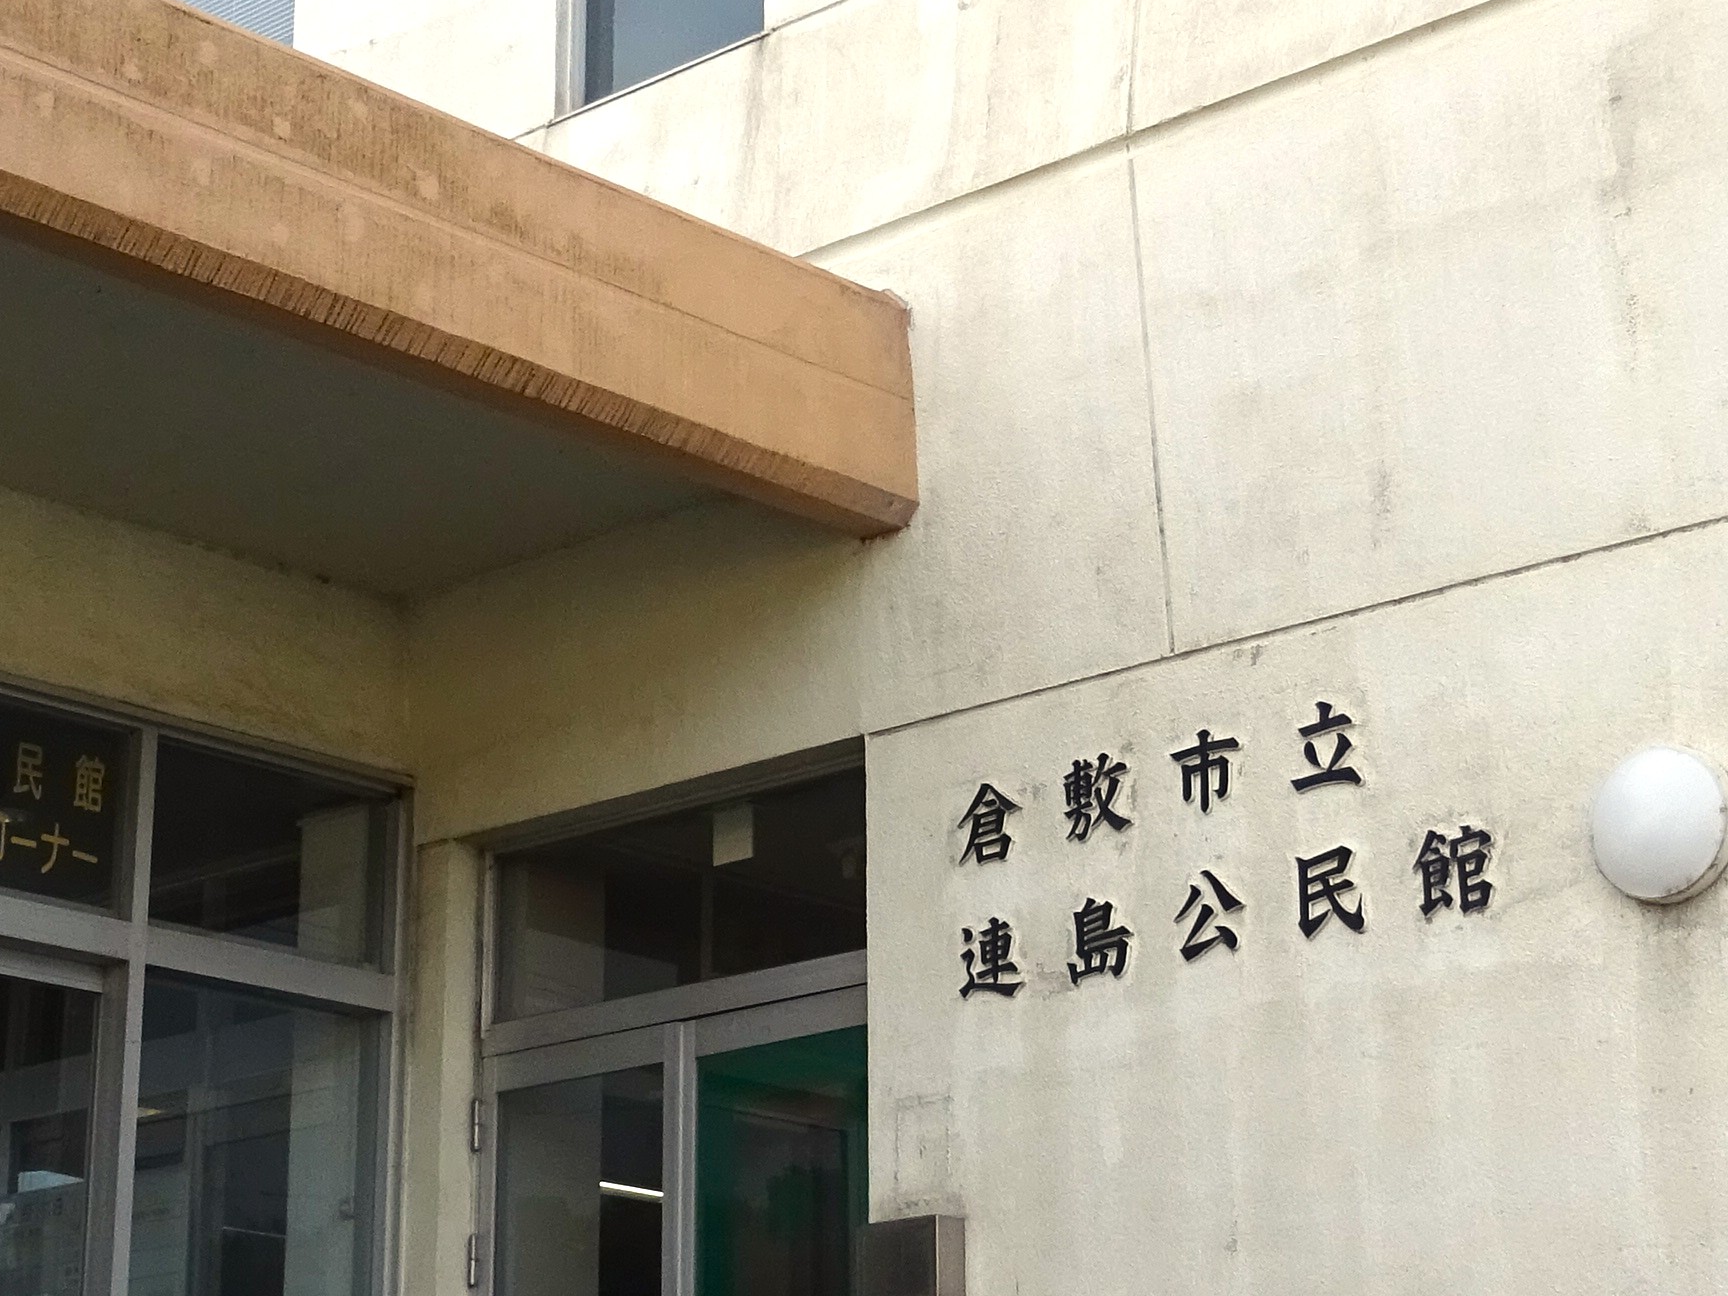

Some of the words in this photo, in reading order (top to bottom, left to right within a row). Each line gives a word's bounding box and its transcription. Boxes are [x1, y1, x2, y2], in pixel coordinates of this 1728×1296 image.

[958, 701, 1364, 866] 倉敷市立
[958, 825, 1495, 1000] 連島公民館
